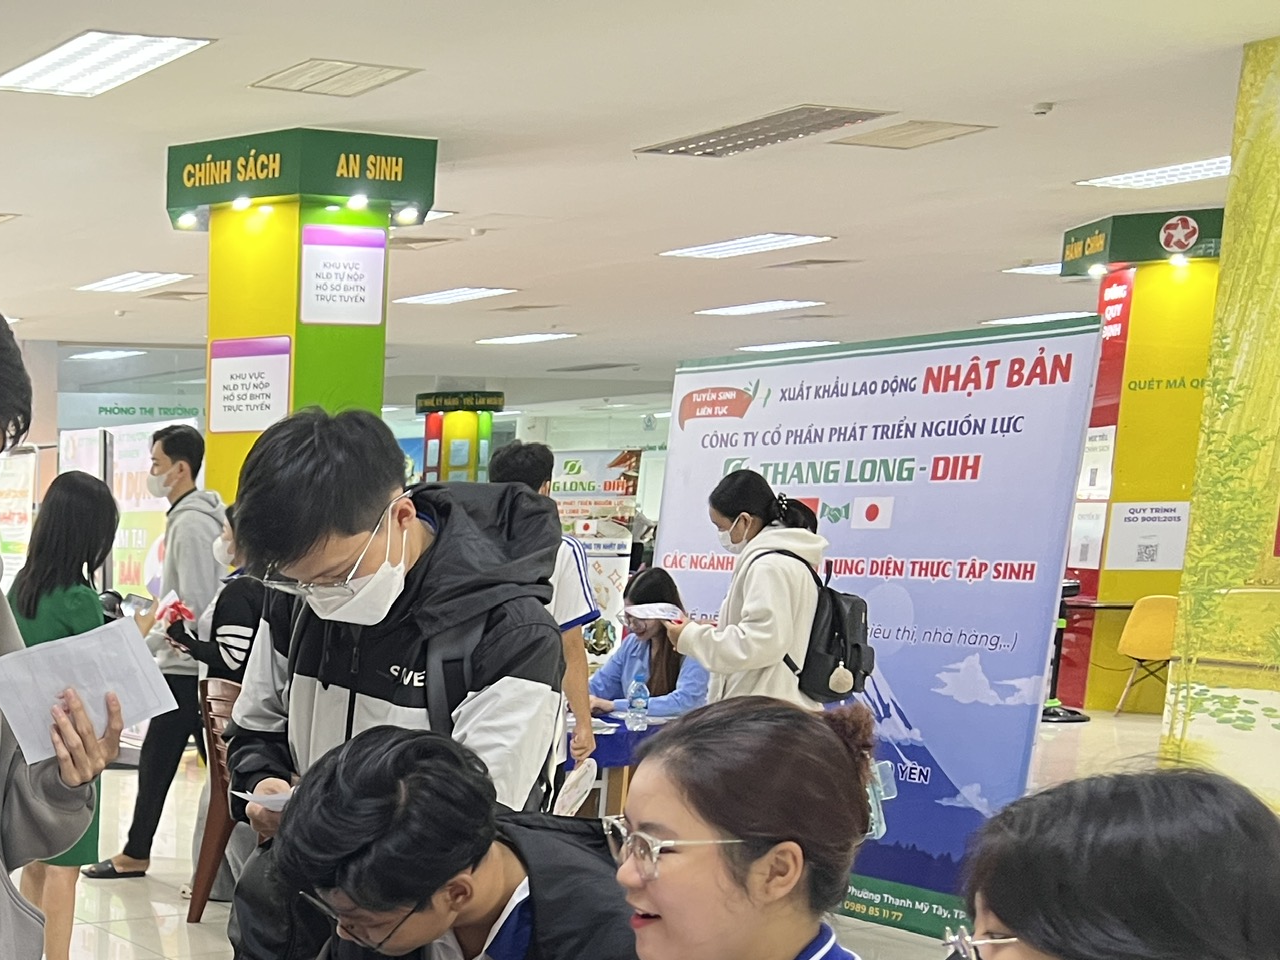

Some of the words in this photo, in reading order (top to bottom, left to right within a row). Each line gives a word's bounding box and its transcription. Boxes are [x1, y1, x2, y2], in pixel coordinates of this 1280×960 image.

[182, 154, 232, 188] CHÍNH
[236, 149, 281, 182] SÁCH
[336, 153, 361, 178] AN
[366, 154, 403, 182] SINH
[322, 261, 341, 270] KHU
[342, 261, 361, 272] VỰC
[343, 284, 366, 293] BHTN
[315, 294, 337, 304] TRỰC
[339, 293, 366, 303] TUYẾN
[1105, 304, 1123, 321] QUY
[230, 373, 247, 381] KHU
[248, 371, 266, 381] VỰC
[779, 380, 812, 402] XUẤT
[814, 376, 848, 400] KHẨU
[851, 380, 878, 397] LAO
[880, 376, 918, 397] ĐỘNG
[921, 355, 1001, 398] NHẬT
[1006, 346, 1073, 389] BẢN
[1128, 379, 1163, 391] QUÉT
[1165, 376, 1186, 389] MÃ
[236, 392, 248, 401] SƠ
[249, 392, 271, 401] BHTN
[692, 389, 717, 402] TUYỂN
[718, 390, 737, 401] SINH
[98, 403, 136, 416] PHÒNG
[139, 406, 155, 417] THỊ
[158, 404, 199, 416] TRƯỜNG
[222, 404, 243, 413] TRỰC
[245, 401, 271, 412] TUYẾN
[695, 405, 712, 416] LIÊN
[713, 405, 729, 417] TỤC
[701, 430, 739, 449] CÔNG
[743, 431, 759, 447] TY
[761, 424, 782, 446] CỔ
[785, 423, 824, 445] PHẦN
[828, 422, 869, 442] PHÁT
[872, 416, 917, 439] TRIỂN
[920, 413, 987, 438] NGUỒN
[990, 415, 1025, 438] LỰC
[844, 457, 916, 483] LONG
[929, 455, 981, 481] DIH
[563, 481, 596, 491] LONG
[603, 480, 627, 491] DIH
[1128, 507, 1147, 515] QUY
[1150, 505, 1177, 514] TRÌNH
[1141, 515, 1182, 523] 9001:2015
[663, 552, 687, 569] CÁC
[689, 552, 735, 571] NGÀNH
[869, 557, 905, 579] DIỆN
[909, 560, 952, 581] THỰC
[956, 558, 988, 583] TẬP
[992, 562, 1036, 581] SINH
[895, 625, 918, 646] thị,
[922, 628, 952, 644] nhà
[898, 761, 931, 783] YÊN
[844, 900, 867, 914] 0989
[868, 904, 880, 916] 85
[882, 908, 890, 919] 11
[891, 910, 903, 922] 77
[915, 900, 930, 914] Mỹ
